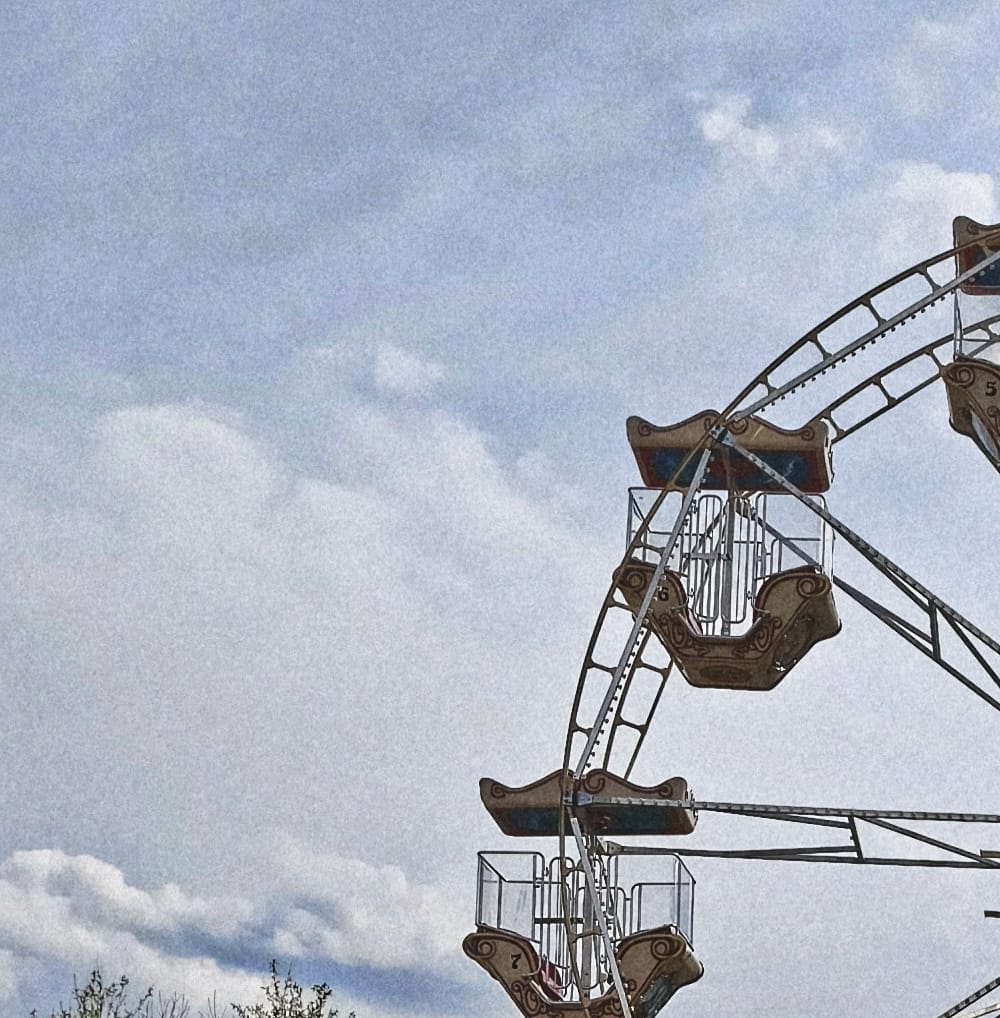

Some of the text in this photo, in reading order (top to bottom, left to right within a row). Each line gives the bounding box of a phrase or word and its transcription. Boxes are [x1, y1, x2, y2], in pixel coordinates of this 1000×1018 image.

[985, 381, 998, 397] 5
[658, 587, 670, 602] 6
[511, 953, 522, 970] 7
